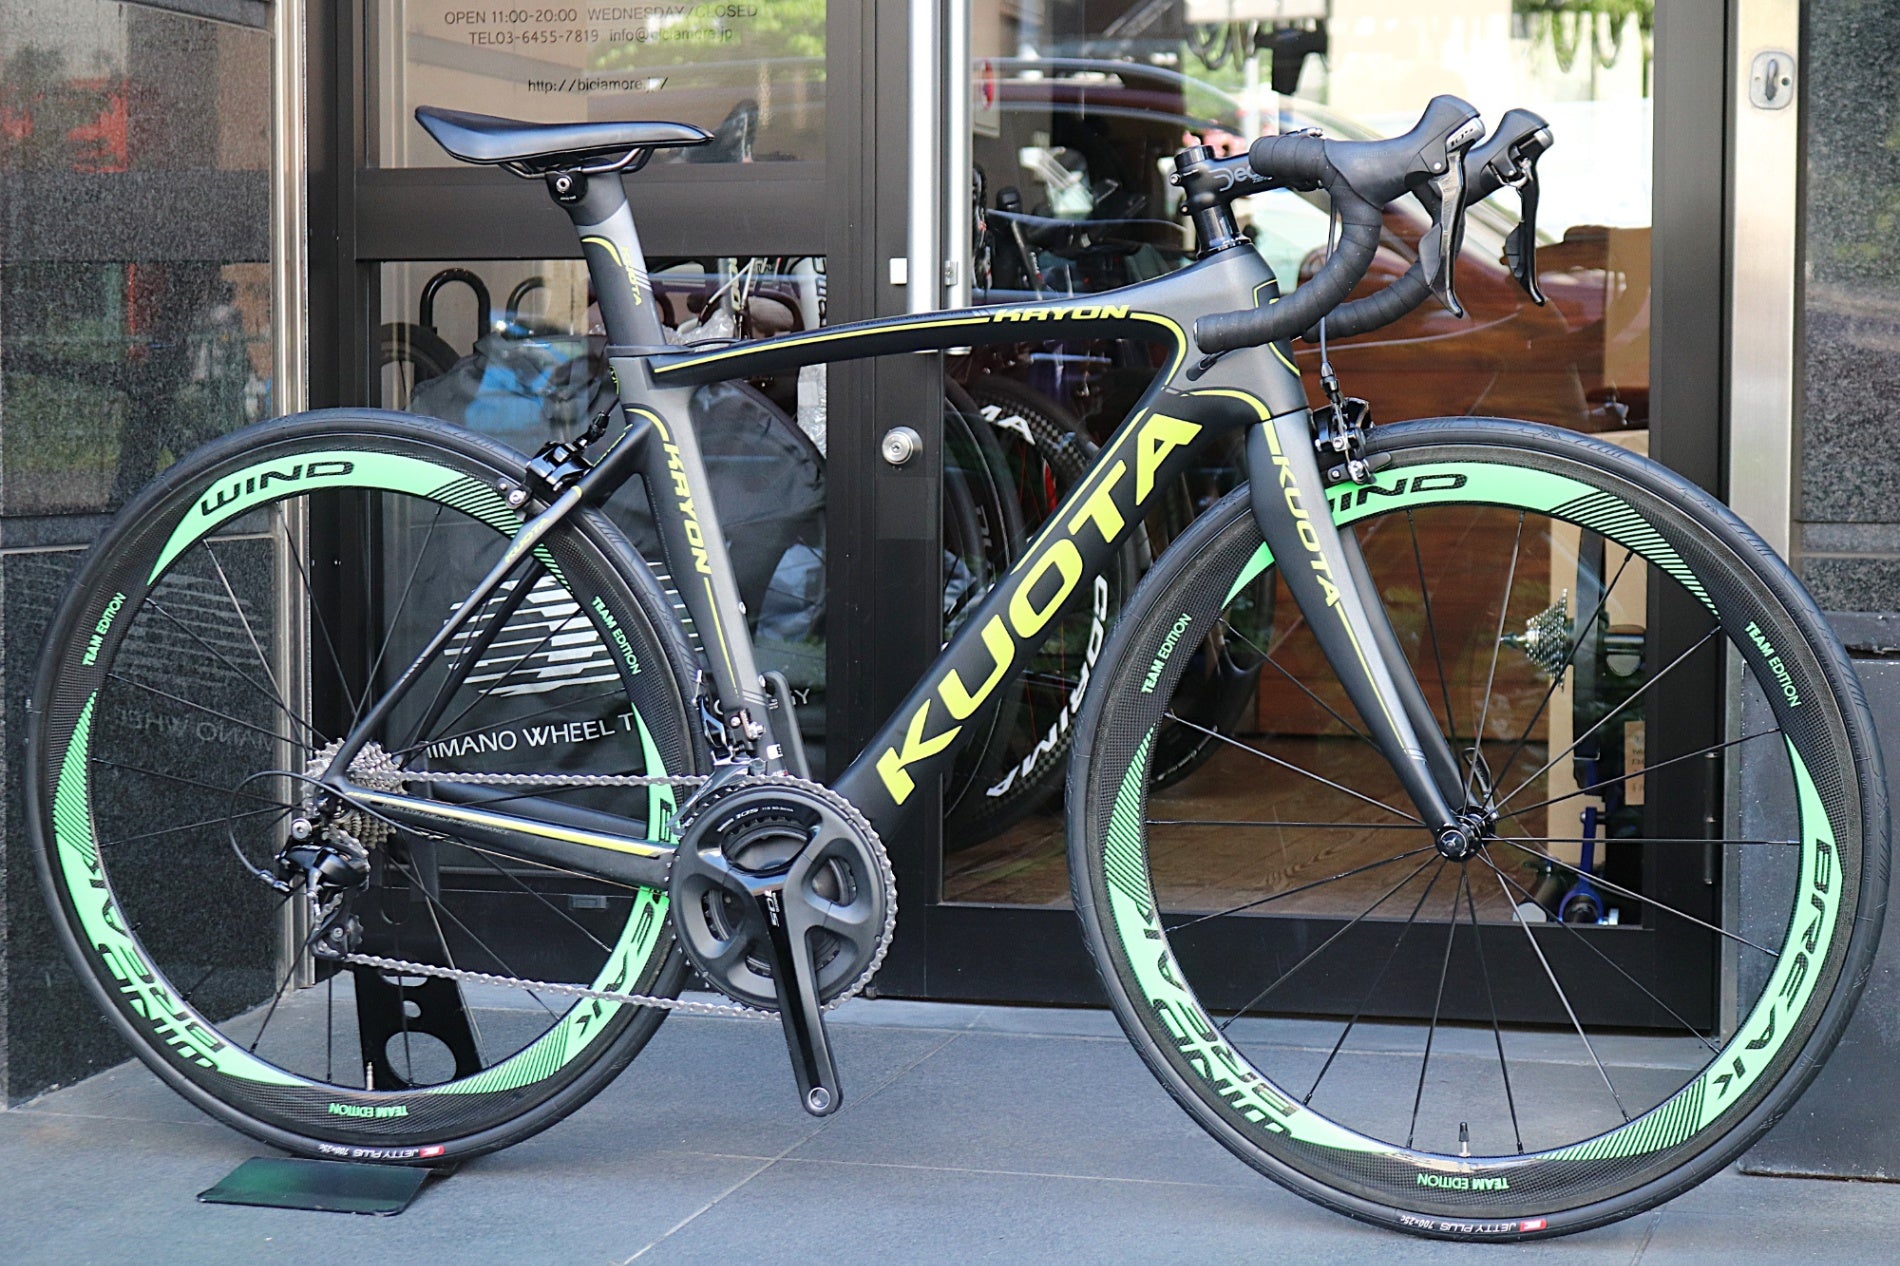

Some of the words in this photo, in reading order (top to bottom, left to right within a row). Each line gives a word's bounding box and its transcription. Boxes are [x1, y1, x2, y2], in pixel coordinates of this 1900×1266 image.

[444, 11, 486, 24] OPEN
[492, 9, 577, 23] 11:00-20:00
[200, 461, 355, 516] WIND
[1328, 473, 1468, 513] IND
[1272, 456, 1342, 607] KUOTA
[876, 412, 1203, 806] KUOTA
[82, 634, 104, 666] TEAM
[95, 592, 127, 635] EDITION
[592, 596, 618, 629] TEAM
[612, 628, 642, 675] EDITION
[1141, 659, 1165, 693] TEAM
[1157, 612, 1192, 660] EDITION
[1745, 621, 1775, 658] TEAM
[1768, 655, 1802, 708] EDITION
[523, 720, 615, 748] WHEEL
[764, 890, 780, 927] 105
[1712, 839, 1832, 1100] BREAK
[328, 1102, 374, 1118] EDITION
[376, 1105, 409, 1118] TEAM
[353, 1148, 383, 1158] PLUS
[382, 1148, 420, 1158] JETTY
[1416, 1173, 1469, 1190] EDITION
[1472, 1177, 1510, 1191] TEAM
[1440, 1222, 1474, 1233] PLUS
[1475, 1221, 1517, 1233] JETTY
